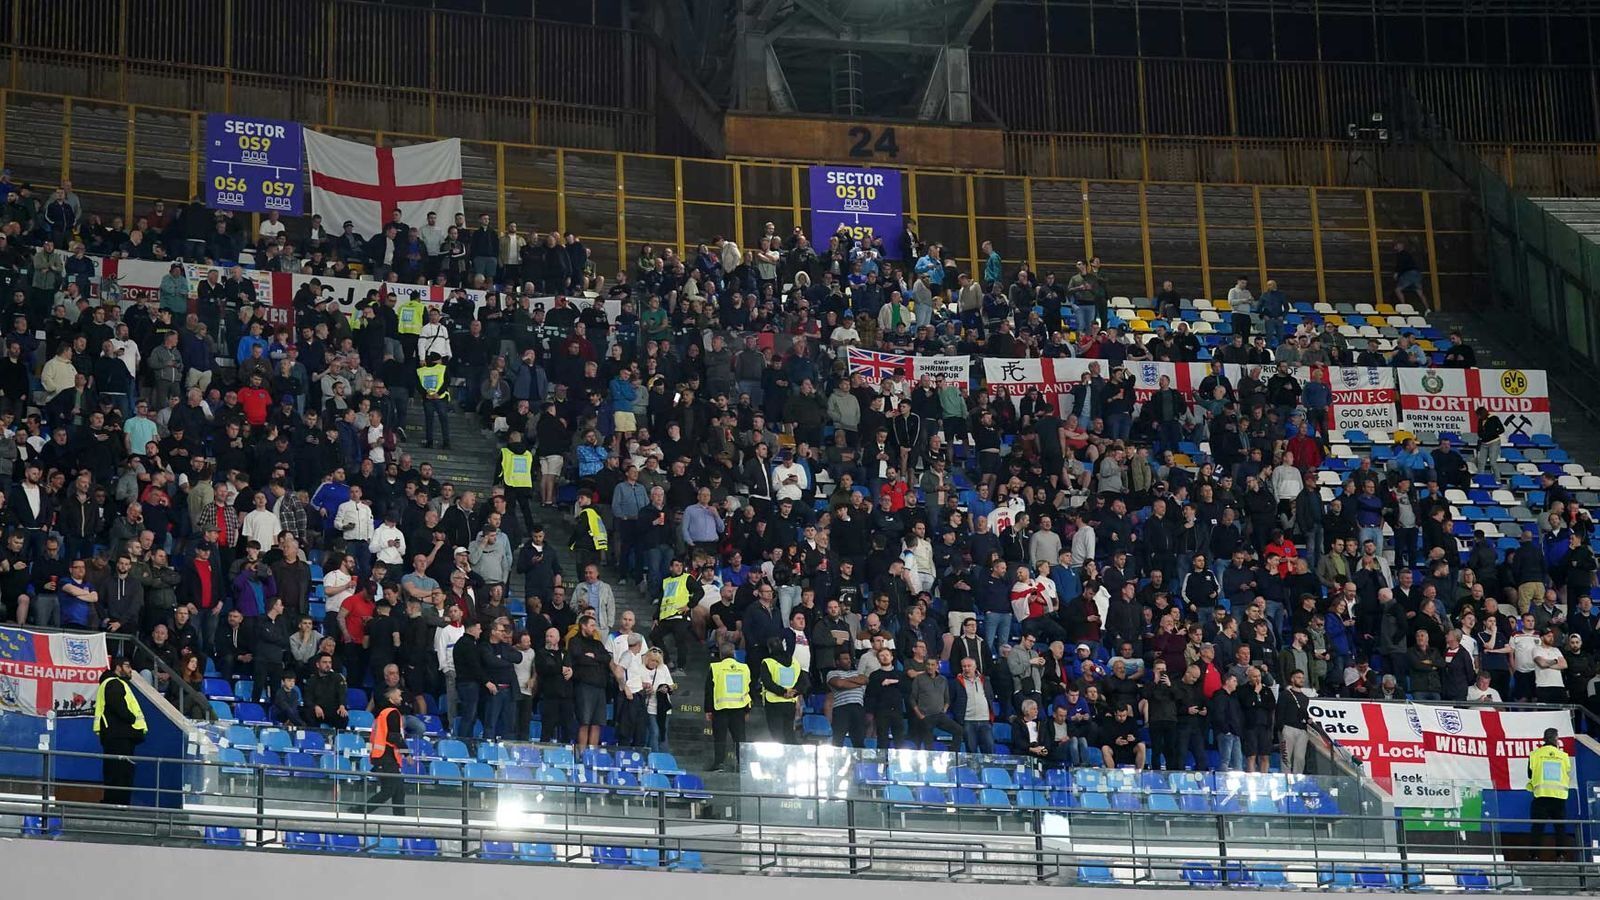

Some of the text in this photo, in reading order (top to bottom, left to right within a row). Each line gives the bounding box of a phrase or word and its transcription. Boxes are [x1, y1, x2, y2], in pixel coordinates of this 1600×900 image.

[224, 119, 285, 138] SECTOR
[848, 126, 900, 158] 24
[826, 171, 884, 187] SECTOR
[919, 364, 964, 373] SHRIMPERS
[1367, 390, 1392, 403] F.C.
[1417, 396, 1533, 412] DORTMUND
[1341, 407, 1389, 418] GOD SAVE
[1340, 419, 1393, 429] OUR QUEEN
[1412, 421, 1461, 430] WITH STEEL
[1308, 705, 1347, 719] Our
[1434, 735, 1488, 756] WIGAN
[1393, 772, 1423, 783] Leek
[1403, 785, 1451, 797] & Stoke
